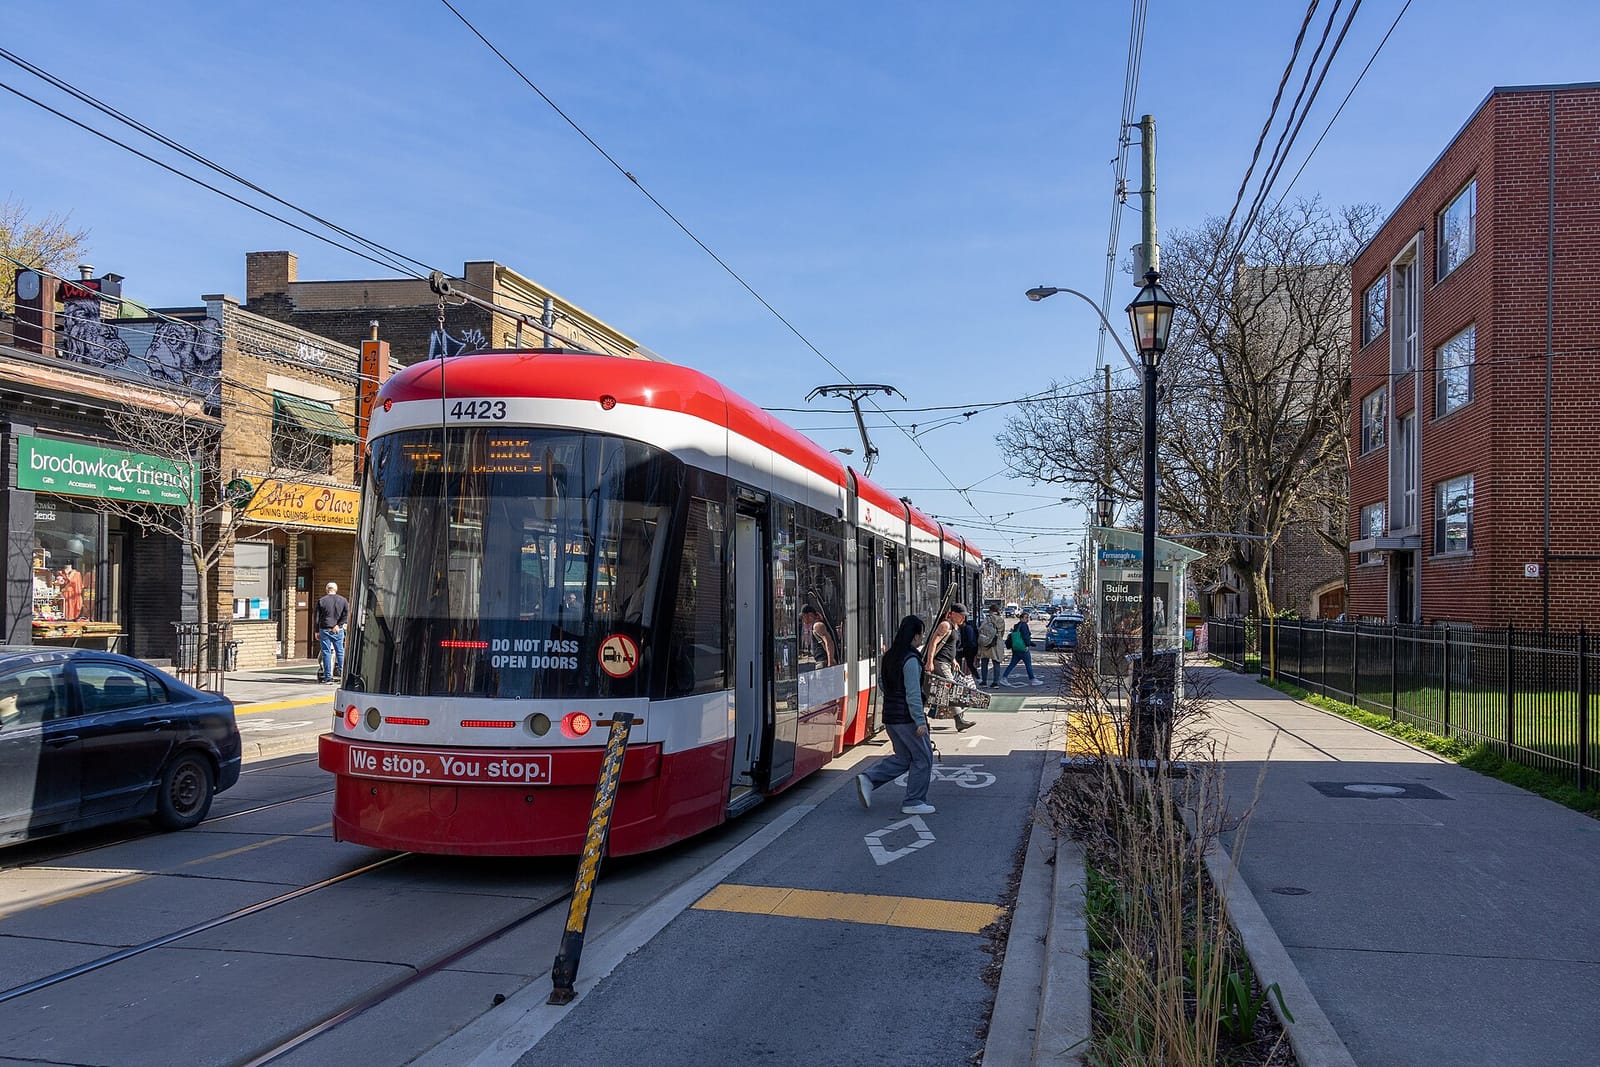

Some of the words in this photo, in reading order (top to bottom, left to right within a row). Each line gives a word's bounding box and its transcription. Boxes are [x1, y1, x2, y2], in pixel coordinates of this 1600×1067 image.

[450, 401, 507, 420] 4423
[314, 489, 353, 514] Place
[1106, 584, 1129, 593] Build
[491, 639, 510, 652] DO
[514, 639, 540, 652] NOT
[544, 640, 579, 653] PASS
[491, 655, 527, 668] OPEN
[531, 656, 578, 670] DOORS
[352, 750, 377, 770] We
[382, 754, 431, 778] stop.
[439, 756, 480, 776] You
[487, 760, 546, 782] stop.
